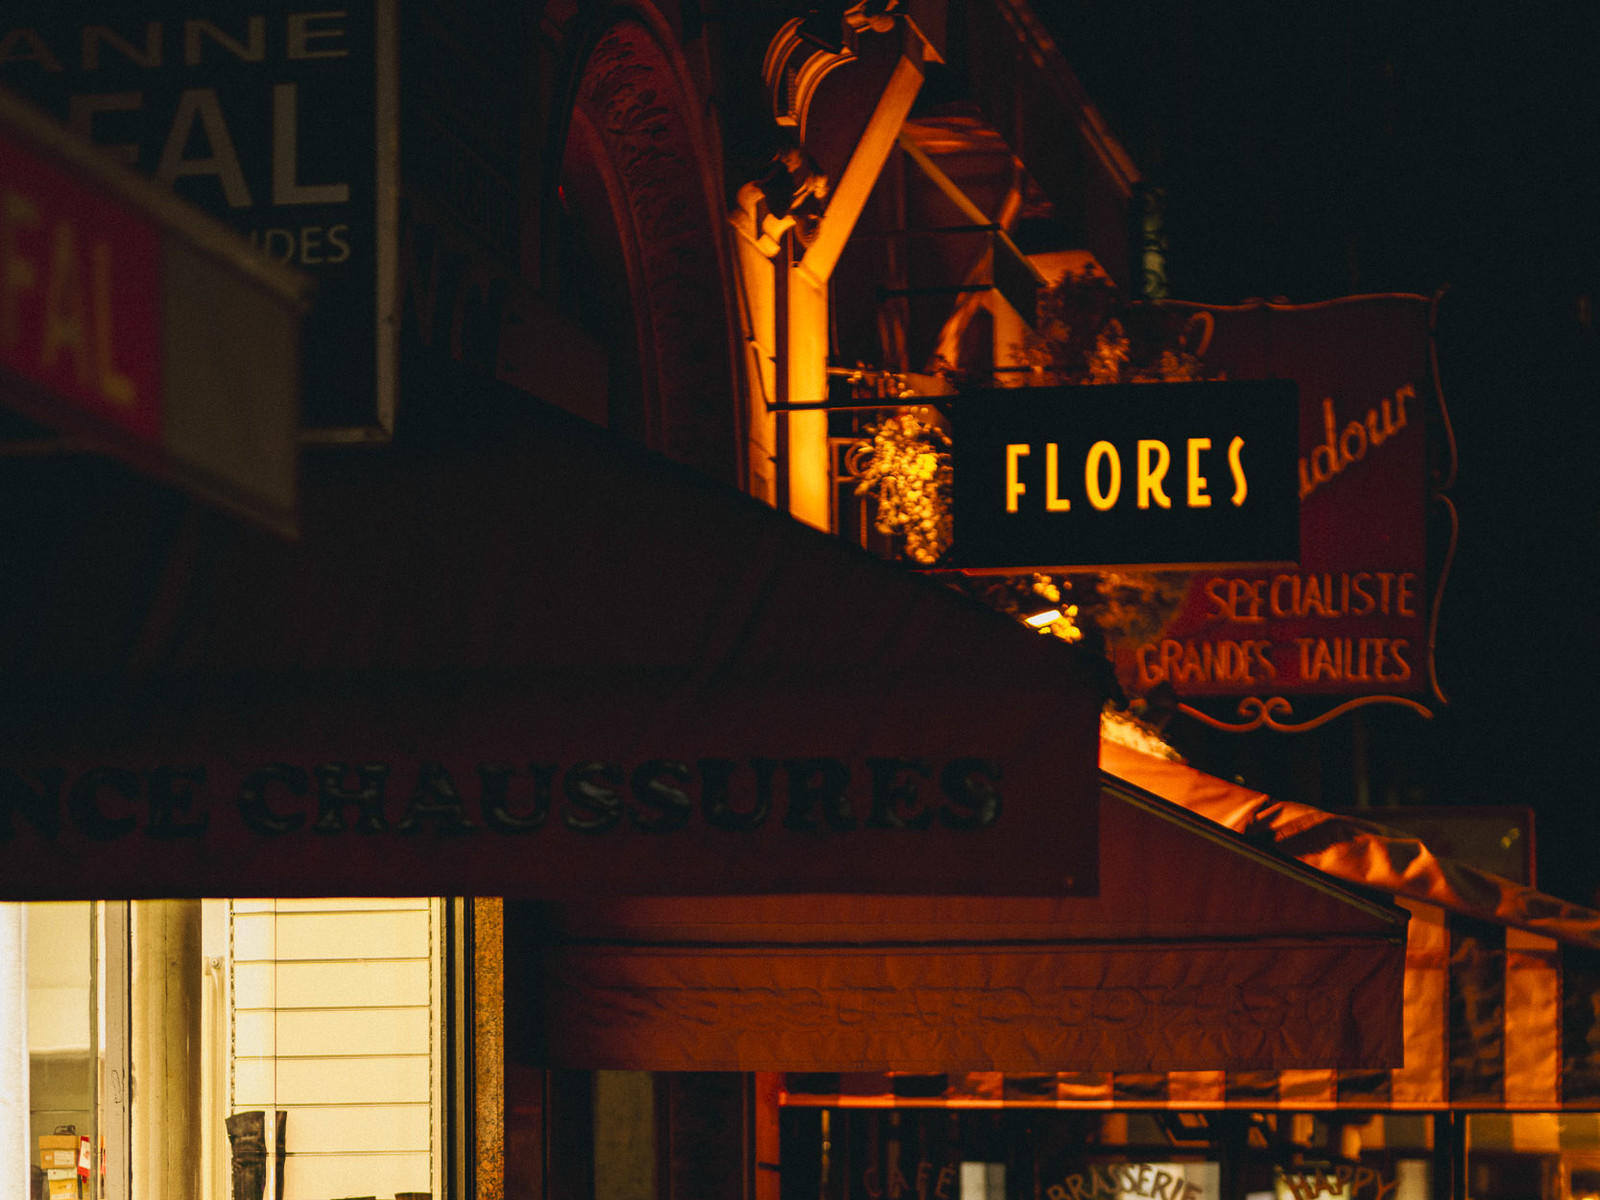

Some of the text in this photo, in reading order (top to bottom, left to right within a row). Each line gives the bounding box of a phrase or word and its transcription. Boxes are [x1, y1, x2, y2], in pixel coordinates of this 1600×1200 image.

[250, 225, 351, 266] DES
[1005, 435, 1248, 513] FLORES
[1136, 637, 1411, 688] GRANDES TAILLES
[238, 757, 1001, 837] CHAUSSURES
